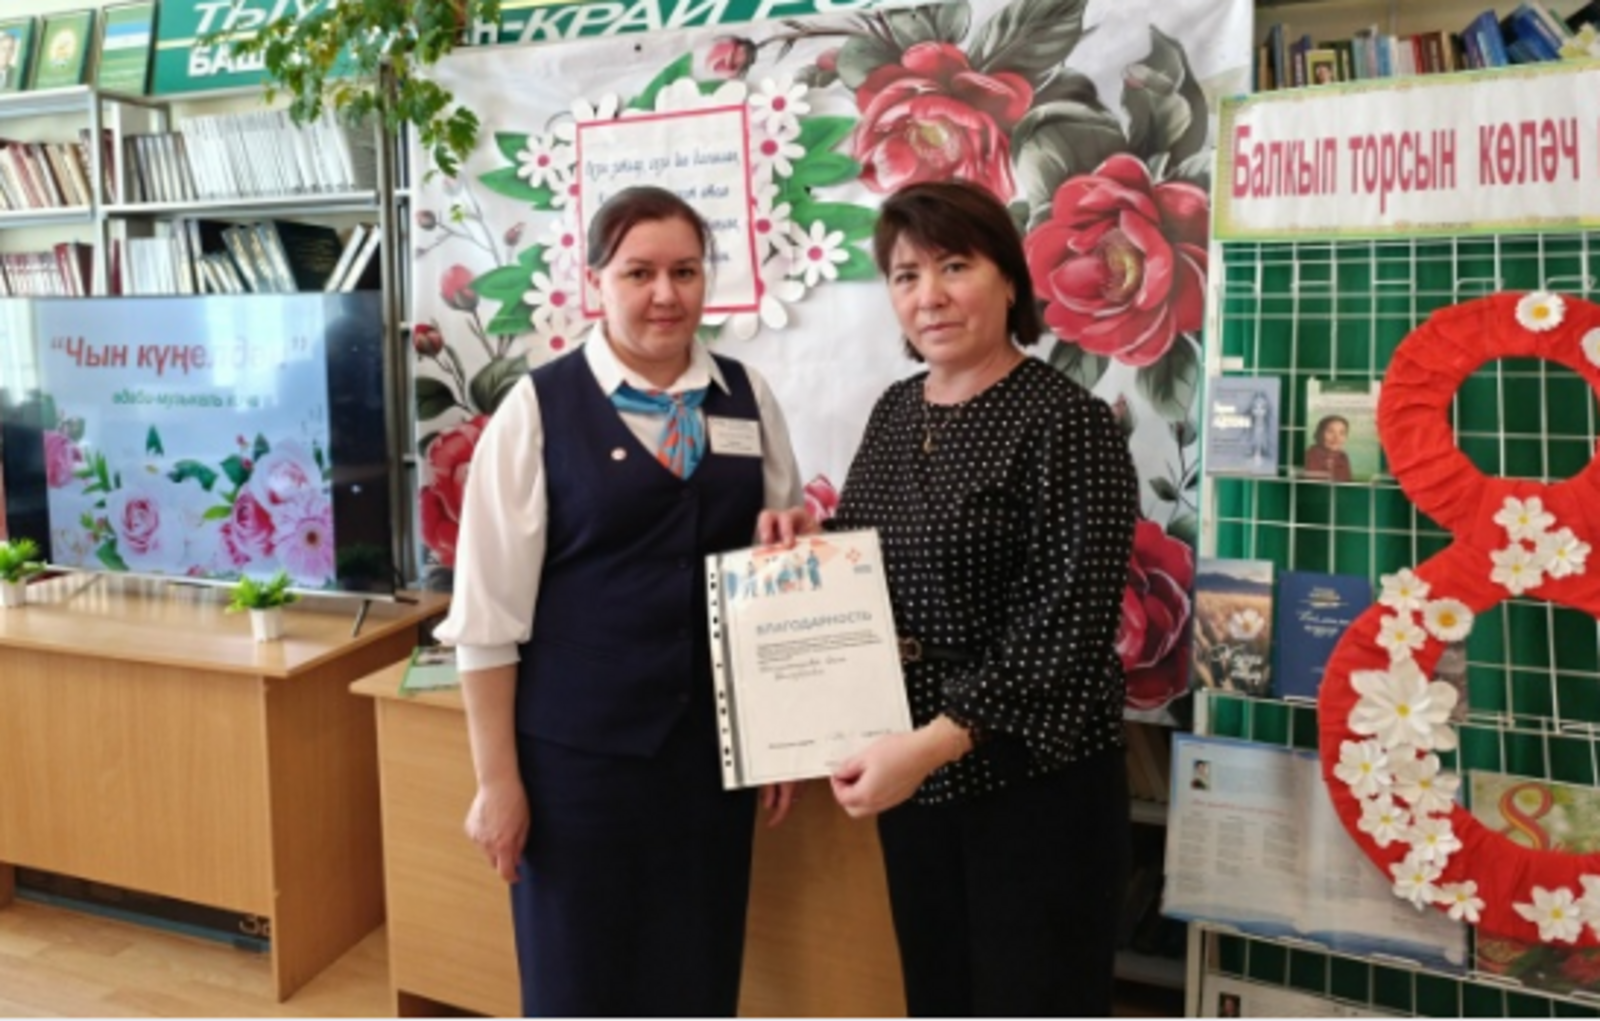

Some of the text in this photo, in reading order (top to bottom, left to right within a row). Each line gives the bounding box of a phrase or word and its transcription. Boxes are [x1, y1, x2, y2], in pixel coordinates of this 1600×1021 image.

[1232, 116, 1580, 215] Балкып торсын көләч
